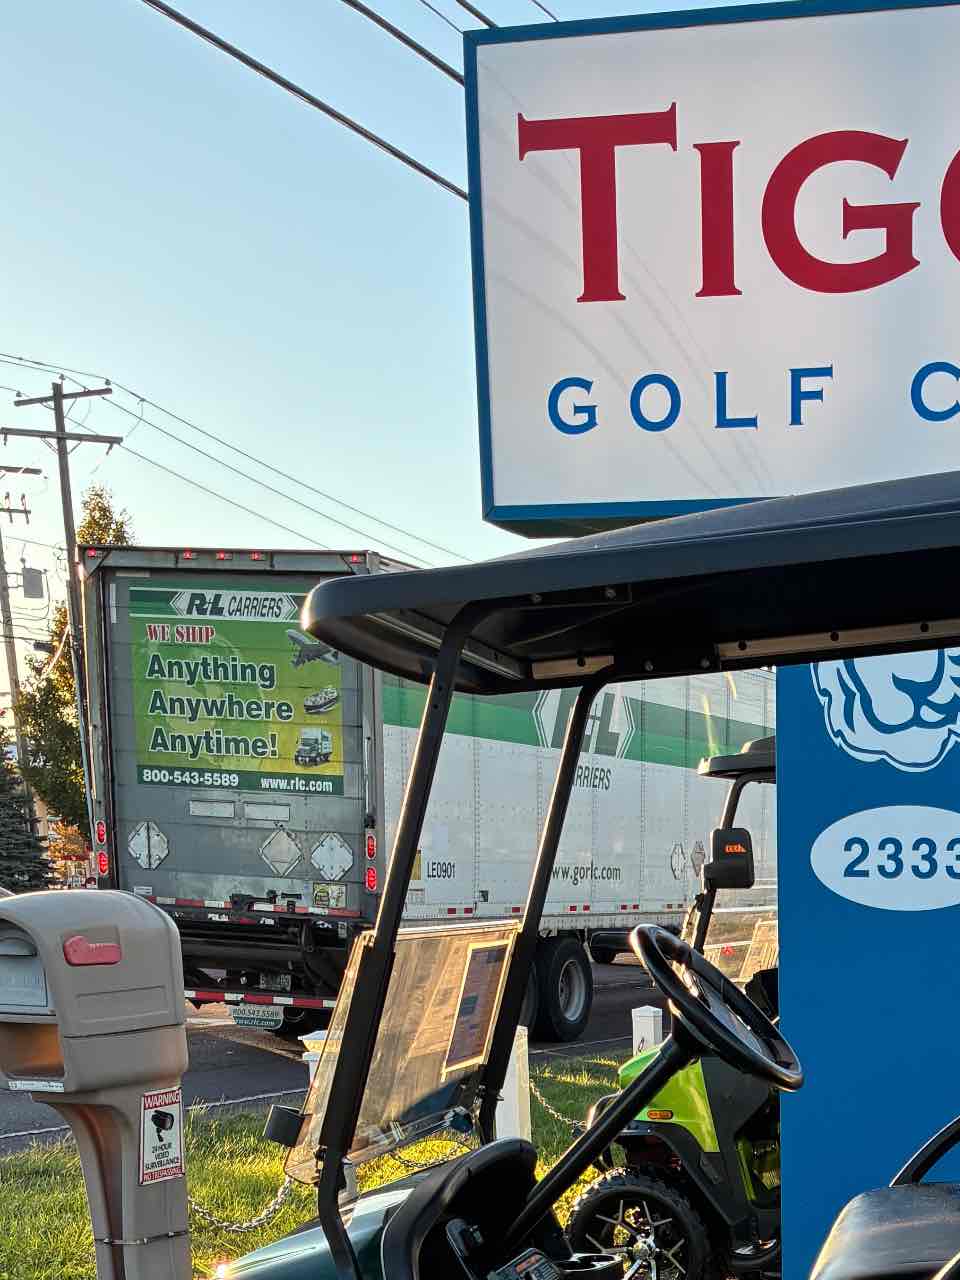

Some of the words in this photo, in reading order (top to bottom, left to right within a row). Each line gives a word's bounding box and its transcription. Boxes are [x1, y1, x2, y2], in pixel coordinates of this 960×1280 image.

[546, 361, 834, 436] GOLF
[227, 595, 283, 618] CARRIERS
[146, 624, 171, 643] WE
[174, 624, 216, 645] SHIP
[146, 652, 276, 690] Anything
[148, 688, 294, 722] Anywhere
[149, 726, 279, 760] Anytime!
[142, 768, 240, 788] 800-543-5589
[260, 776, 333, 793] www.rlc.com
[574, 765, 612, 791] RRIERS
[426, 861, 456, 879] LE0901
[552, 862, 621, 885] ww.gorlc.com
[145, 1091, 180, 1107] WARNING
